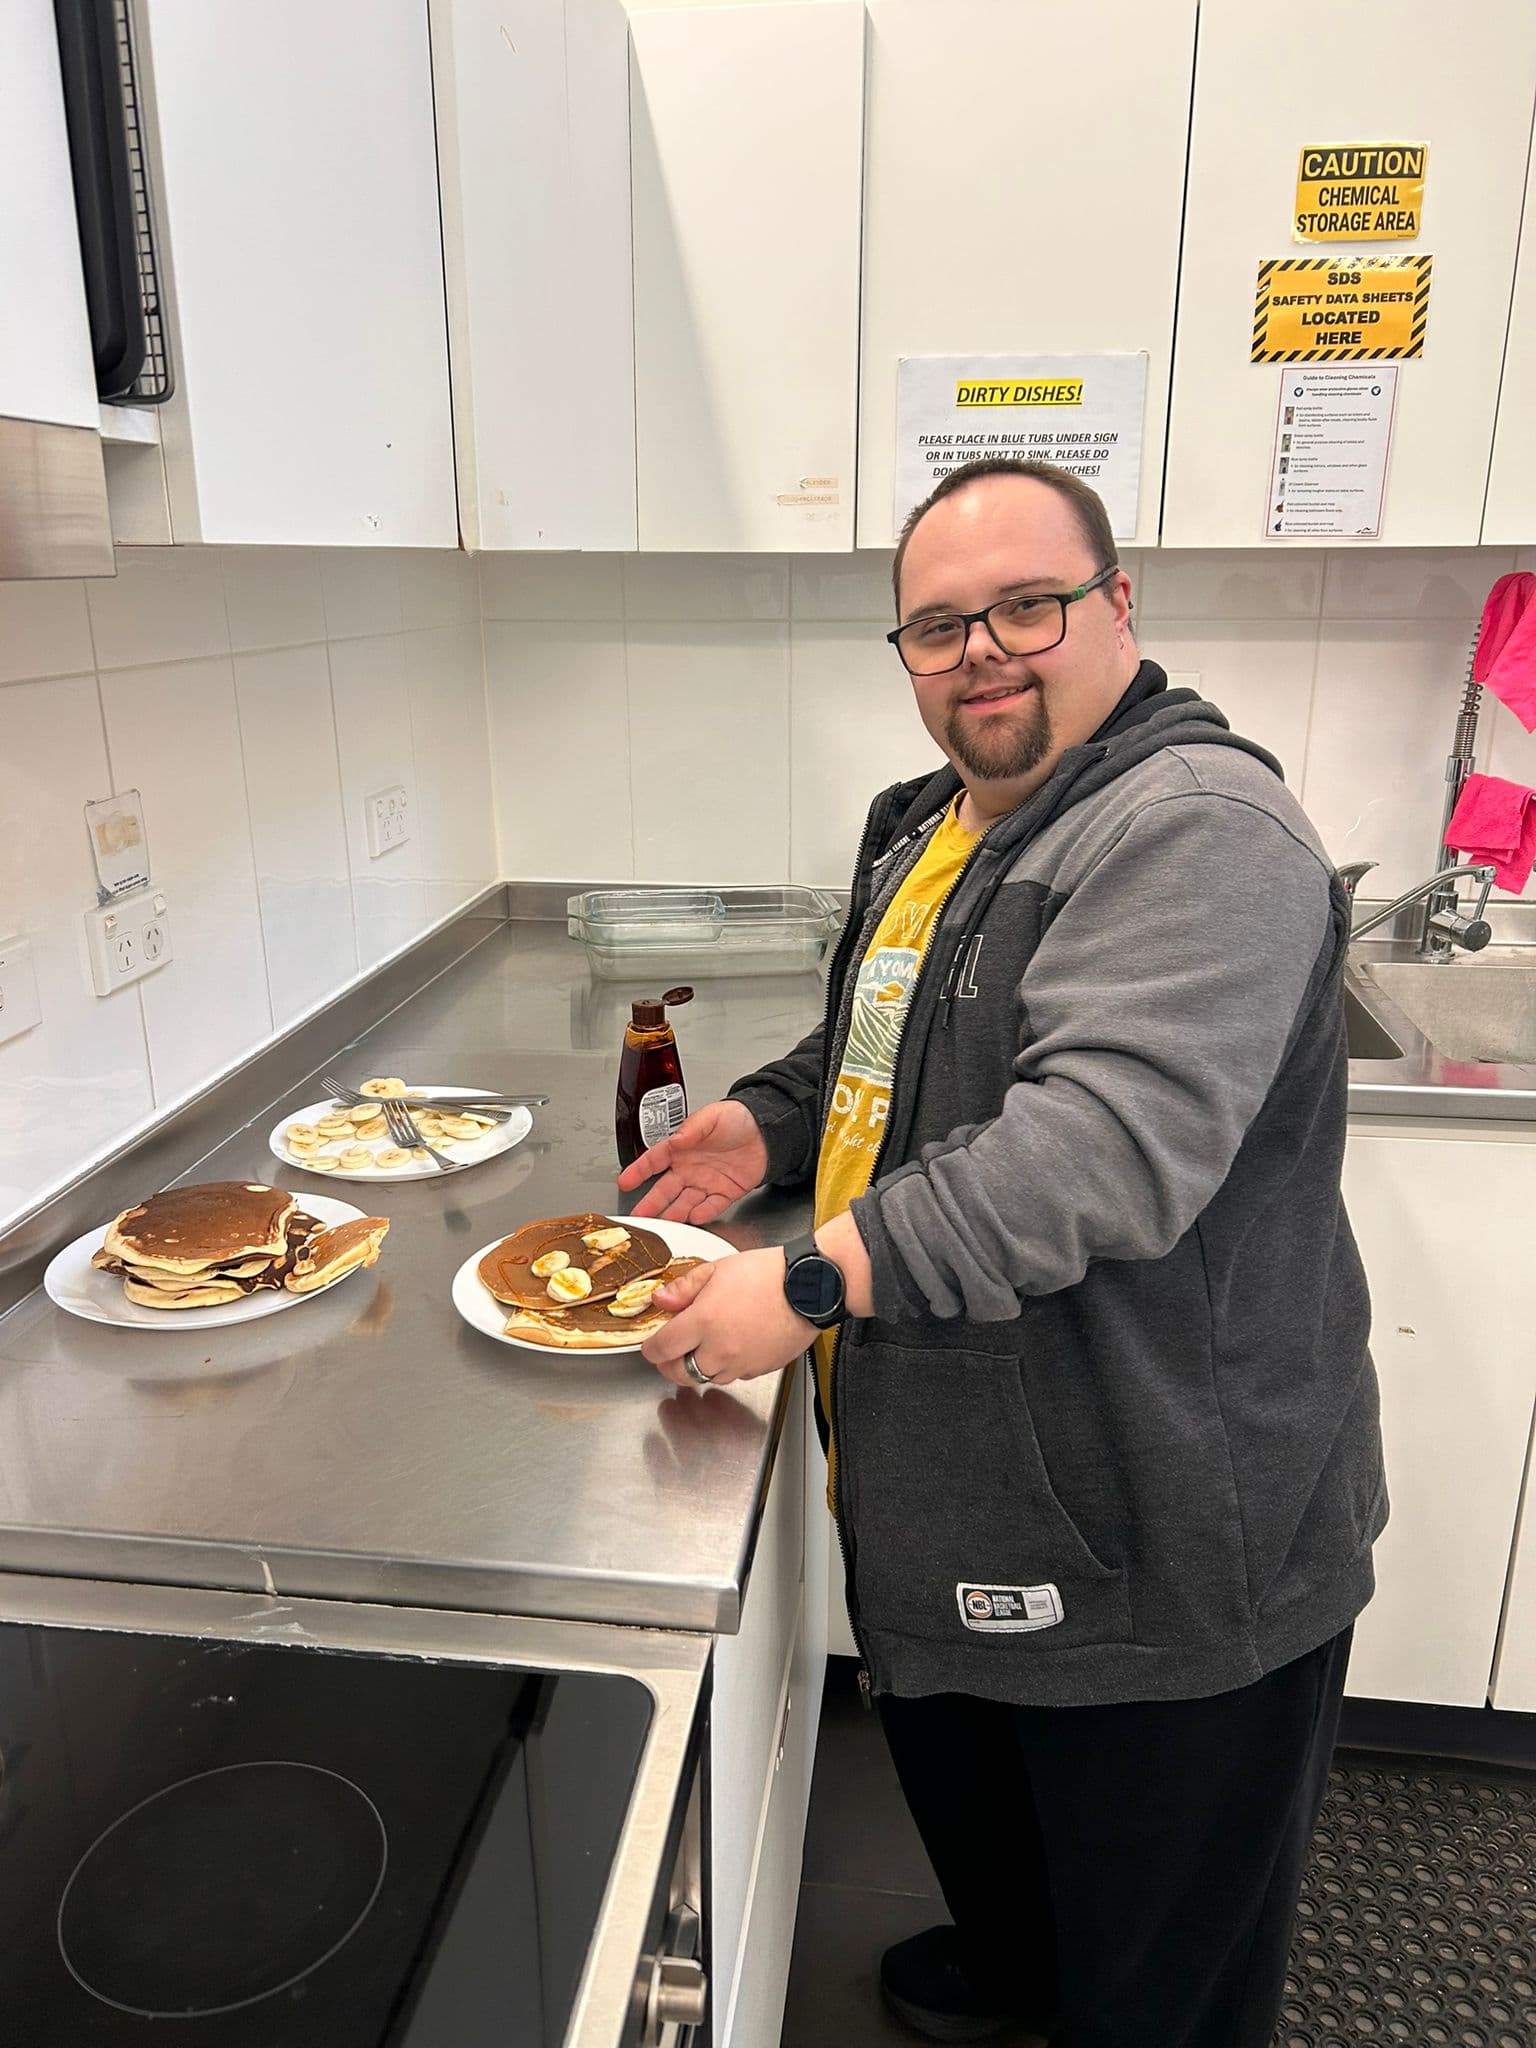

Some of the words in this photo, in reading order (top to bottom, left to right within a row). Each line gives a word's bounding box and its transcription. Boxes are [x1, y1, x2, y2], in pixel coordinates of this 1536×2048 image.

[1304, 150, 1421, 177] CAUTION
[1318, 185, 1400, 207] CHEMICAL
[1296, 212, 1371, 233] STORAGE
[1374, 211, 1416, 231] AREA
[1327, 272, 1361, 285] SDS
[1272, 294, 1323, 306] SAFETY
[1326, 293, 1359, 304] DATA
[1362, 292, 1413, 303] SHEETS
[1302, 311, 1380, 325] LOCATED
[1315, 331, 1362, 345] HERE
[957, 386, 1010, 403] DIRTY
[1013, 384, 1083, 402] DISHES!
[918, 435, 953, 444] PLEASE
[955, 434, 985, 444] PLACE
[988, 434, 999, 443] IN
[1001, 434, 1026, 443] BLUE
[1028, 433, 1053, 443] TUBS
[1056, 433, 1091, 442] UNDER
[1093, 432, 1118, 442] SIGN
[925, 451, 941, 460] OR
[942, 451, 954, 460] IN
[956, 451, 981, 460] TUBS
[983, 450, 1009, 459] NEXT
[1012, 450, 1025, 459] TO
[1027, 450, 1053, 459] SINK.
[1055, 449, 1091, 459] PLEASE
[1093, 449, 1109, 458] DO
[972, 1599, 987, 1610] NBL
